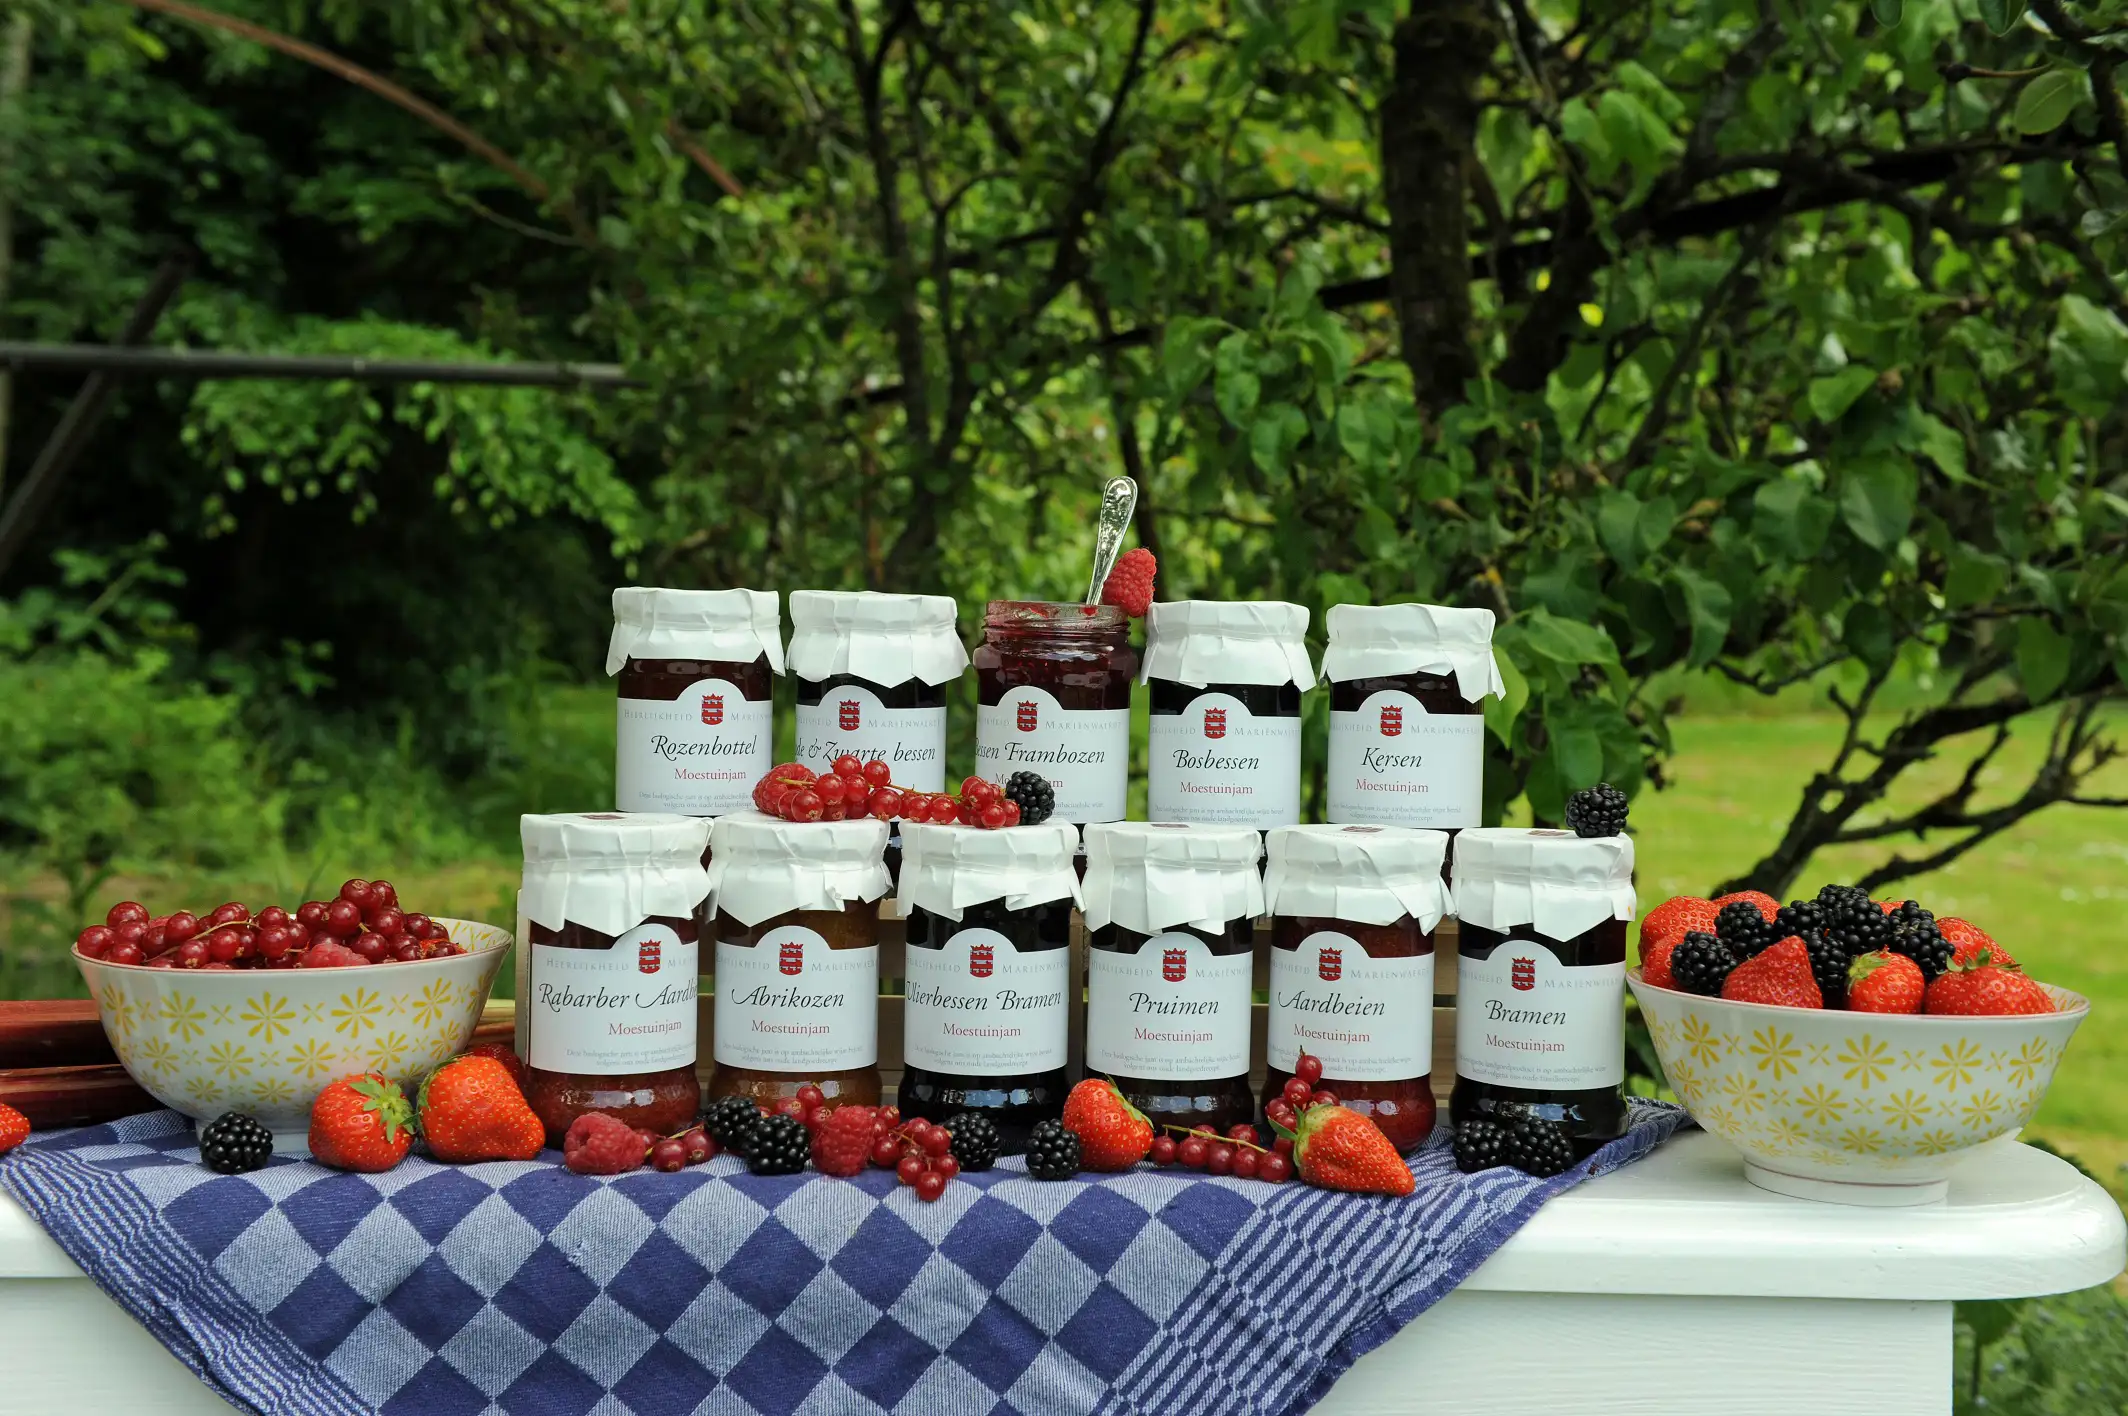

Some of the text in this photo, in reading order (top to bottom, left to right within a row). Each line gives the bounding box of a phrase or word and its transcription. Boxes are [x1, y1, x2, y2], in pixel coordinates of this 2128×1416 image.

[651, 735, 757, 761] Rozenbottel
[809, 738, 821, 759] &
[894, 742, 935, 762] bessen
[1005, 742, 1105, 764] Frambozen
[1173, 749, 1259, 769] Bosbessen
[1361, 748, 1421, 773] Kersen
[674, 768, 747, 783] Moestuinjam
[1180, 782, 1253, 797] Moestuinjam
[1356, 779, 1428, 795] Moestuinjam
[539, 983, 630, 1012] Rabarber
[732, 985, 844, 1008] Abrikozen
[996, 990, 1061, 1011] Bramen
[1129, 993, 1219, 1015] Pruimen
[1278, 990, 1384, 1016] Aardbeien
[1485, 1000, 1566, 1025] Bramen
[608, 1020, 681, 1036] Moestuinjam
[751, 1019, 830, 1037] Moestuinjam
[942, 1022, 1021, 1040] Moestuinjam
[1134, 1027, 1213, 1045] Moestuinjam
[1294, 1024, 1370, 1045] Moestuinjam
[1486, 1034, 1565, 1054] Moestuinjam
